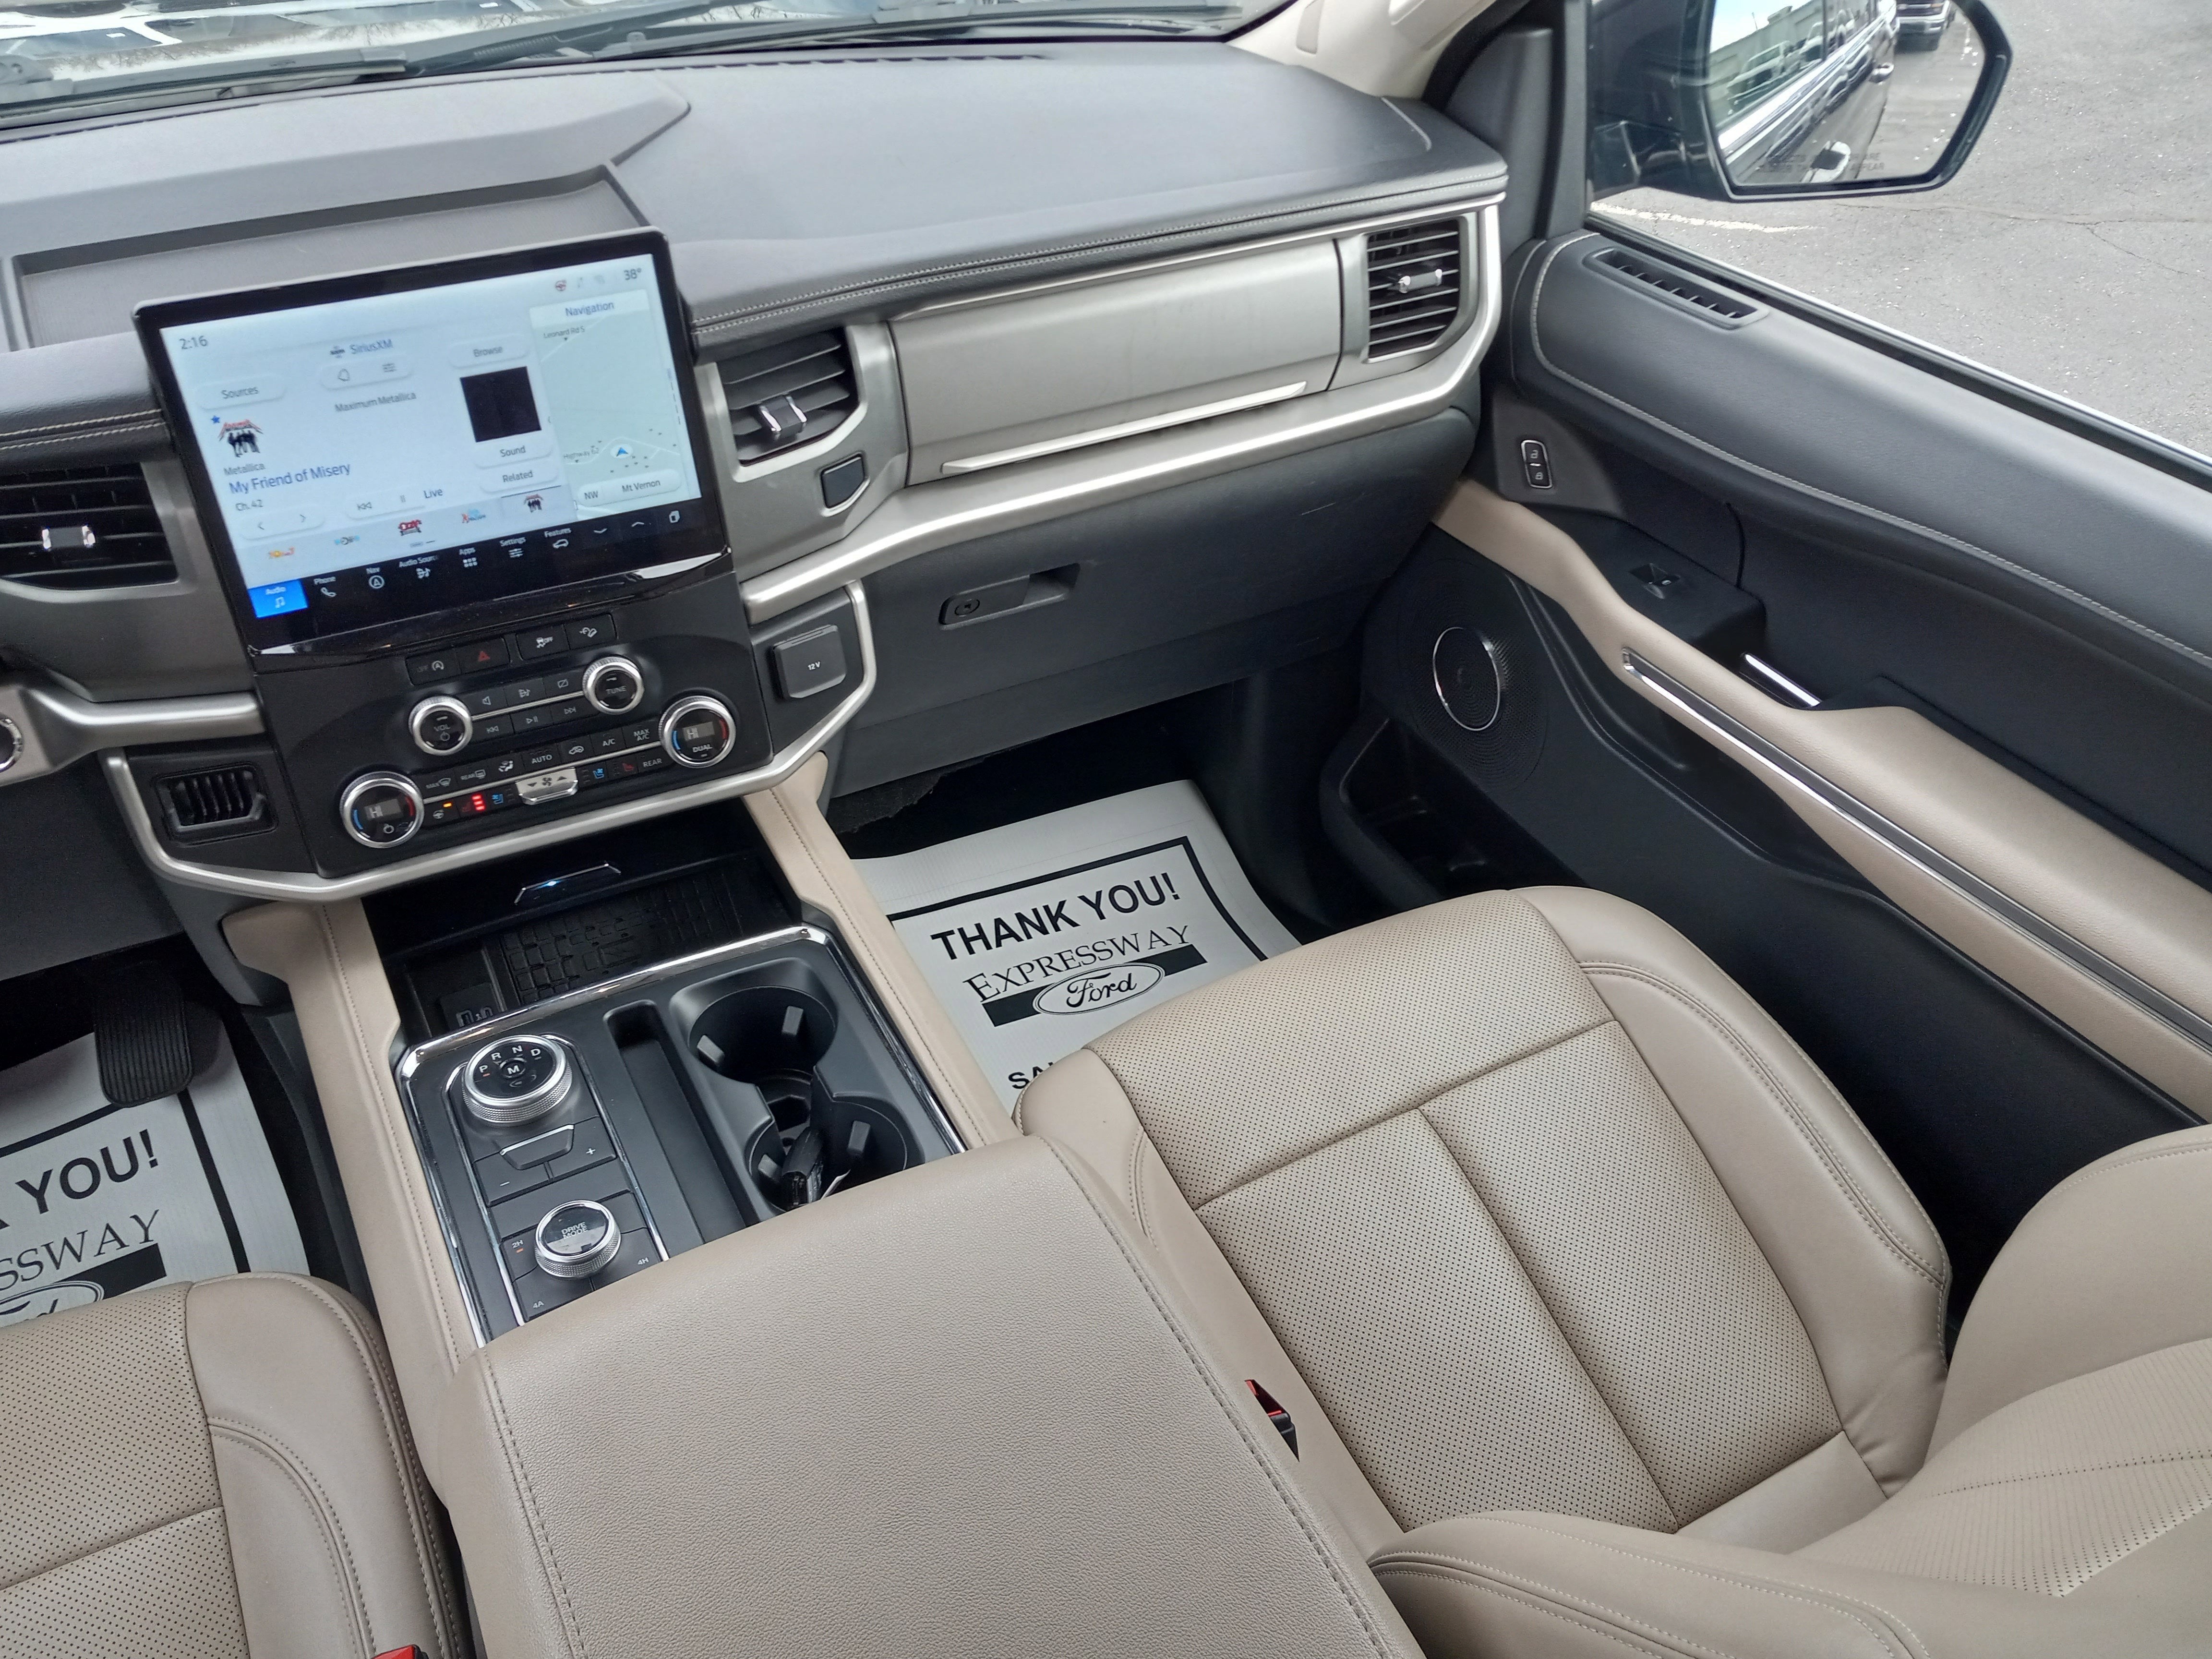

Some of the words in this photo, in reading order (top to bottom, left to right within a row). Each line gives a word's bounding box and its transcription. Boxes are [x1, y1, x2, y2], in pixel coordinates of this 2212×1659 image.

[565, 301, 614, 317] Navigation
[180, 335, 208, 350] 2:16
[349, 338, 394, 355] SiriusXM
[473, 345, 503, 358] Browse
[221, 385, 258, 399] Sources
[334, 397, 377, 412] Maximum
[377, 391, 417, 406] Metallica
[499, 445, 526, 458] Sound
[223, 463, 265, 476] Metallica
[228, 481, 249, 494] My
[251, 472, 293, 490] Friend
[295, 469, 308, 482] of
[310, 464, 350, 480] Misery
[502, 469, 533, 483] Related
[622, 484, 633, 493] Mt
[634, 480, 661, 490] Vernon
[423, 487, 443, 500] Live
[584, 491, 599, 500] NW
[544, 527, 571, 539] Features
[499, 536, 527, 548] Settings
[459, 547, 476, 556] Apps
[399, 559, 418, 568] Audio
[366, 566, 380, 575] Nav
[313, 576, 337, 585] Phone
[265, 586, 287, 595] Audio
[807, 661, 821, 671] 12V
[605, 685, 627, 695] TUNE
[433, 723, 451, 733] VOL
[633, 728, 650, 737] MAX
[602, 738, 616, 747] A/C
[637, 733, 650, 742] A/C
[692, 744, 713, 753] DUAL
[531, 754, 553, 764] AUTO
[643, 757, 662, 768] REAR
[929, 899, 1080, 960] THANK
[1077, 872, 1181, 921] YOU!
[962, 925, 1190, 1002] EXPRESSWAY
[1066, 972, 1137, 1008] Ford
[491, 1052, 502, 1061] R
[512, 1045, 523, 1054] N
[530, 1048, 541, 1057] D
[479, 1065, 489, 1073] P
[507, 1065, 520, 1075] M
[15, 1129, 159, 1214] YOU!
[561, 1221, 586, 1236] DRIVE
[563, 1226, 588, 1239] MODE
[511, 1239, 524, 1249] 2H
[637, 1256, 649, 1266] 4H
[532, 1300, 545, 1310] 4A
